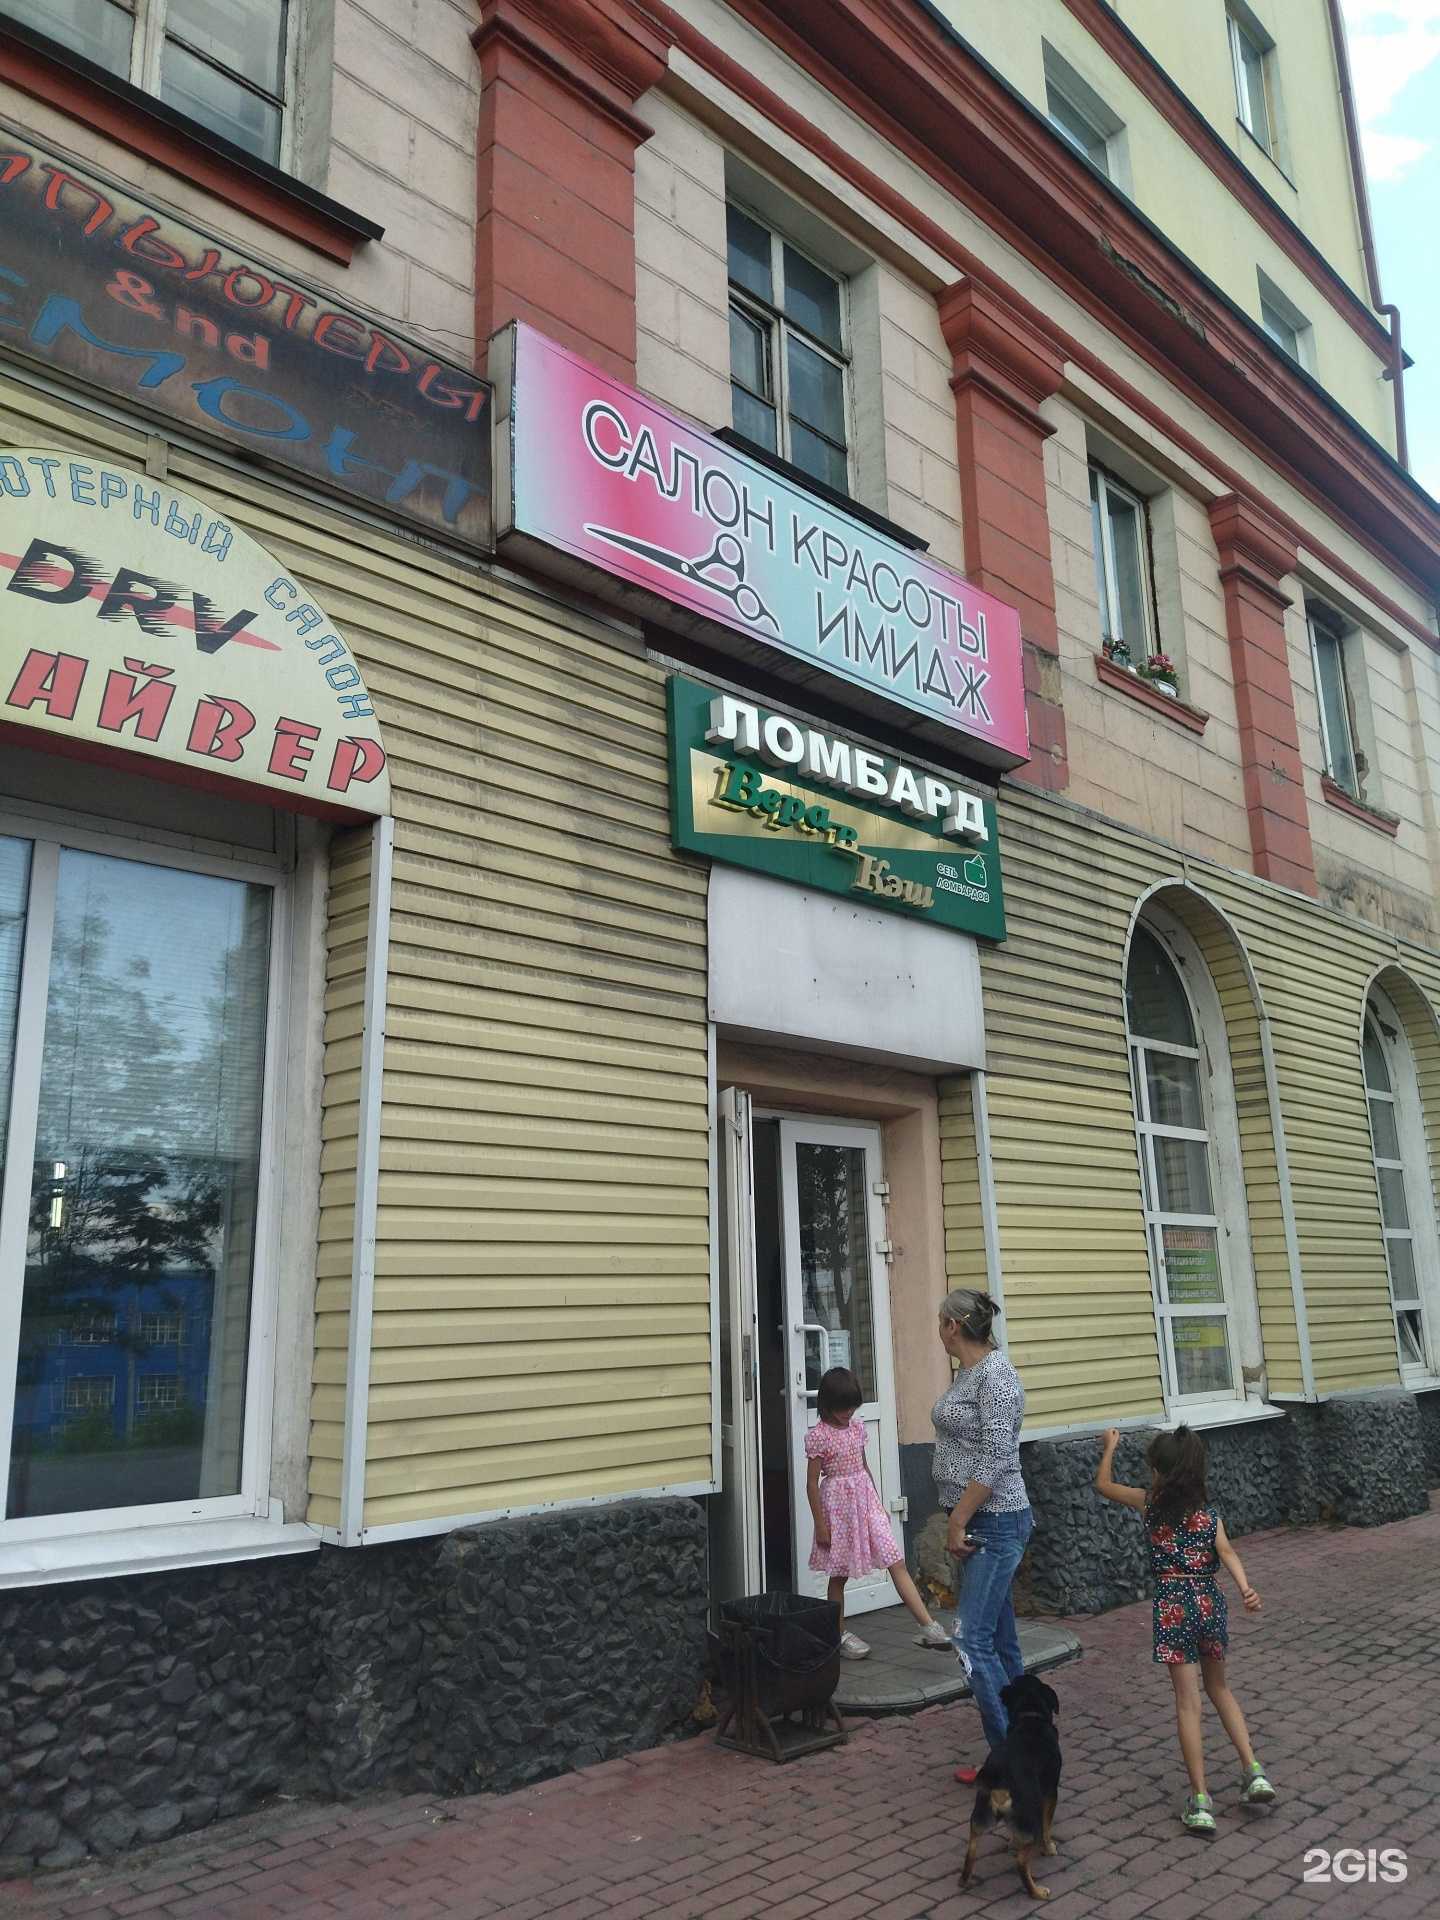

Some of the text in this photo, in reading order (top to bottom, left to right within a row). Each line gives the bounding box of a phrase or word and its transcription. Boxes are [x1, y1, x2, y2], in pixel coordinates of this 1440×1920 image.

[6, 538, 259, 655] DRV
[581, 400, 990, 662] САЛОН КРАСОТЫ
[264, 577, 375, 719] САЛОН
[815, 590, 992, 725] ИМИДЖ
[6, 648, 386, 793] АЙВЕР
[706, 695, 989, 842] ЛОМБАРД
[709, 761, 838, 834] Вера
[936, 862, 959, 879] СЕТЬ
[936, 876, 990, 903] ЛОМБАРДОВ
